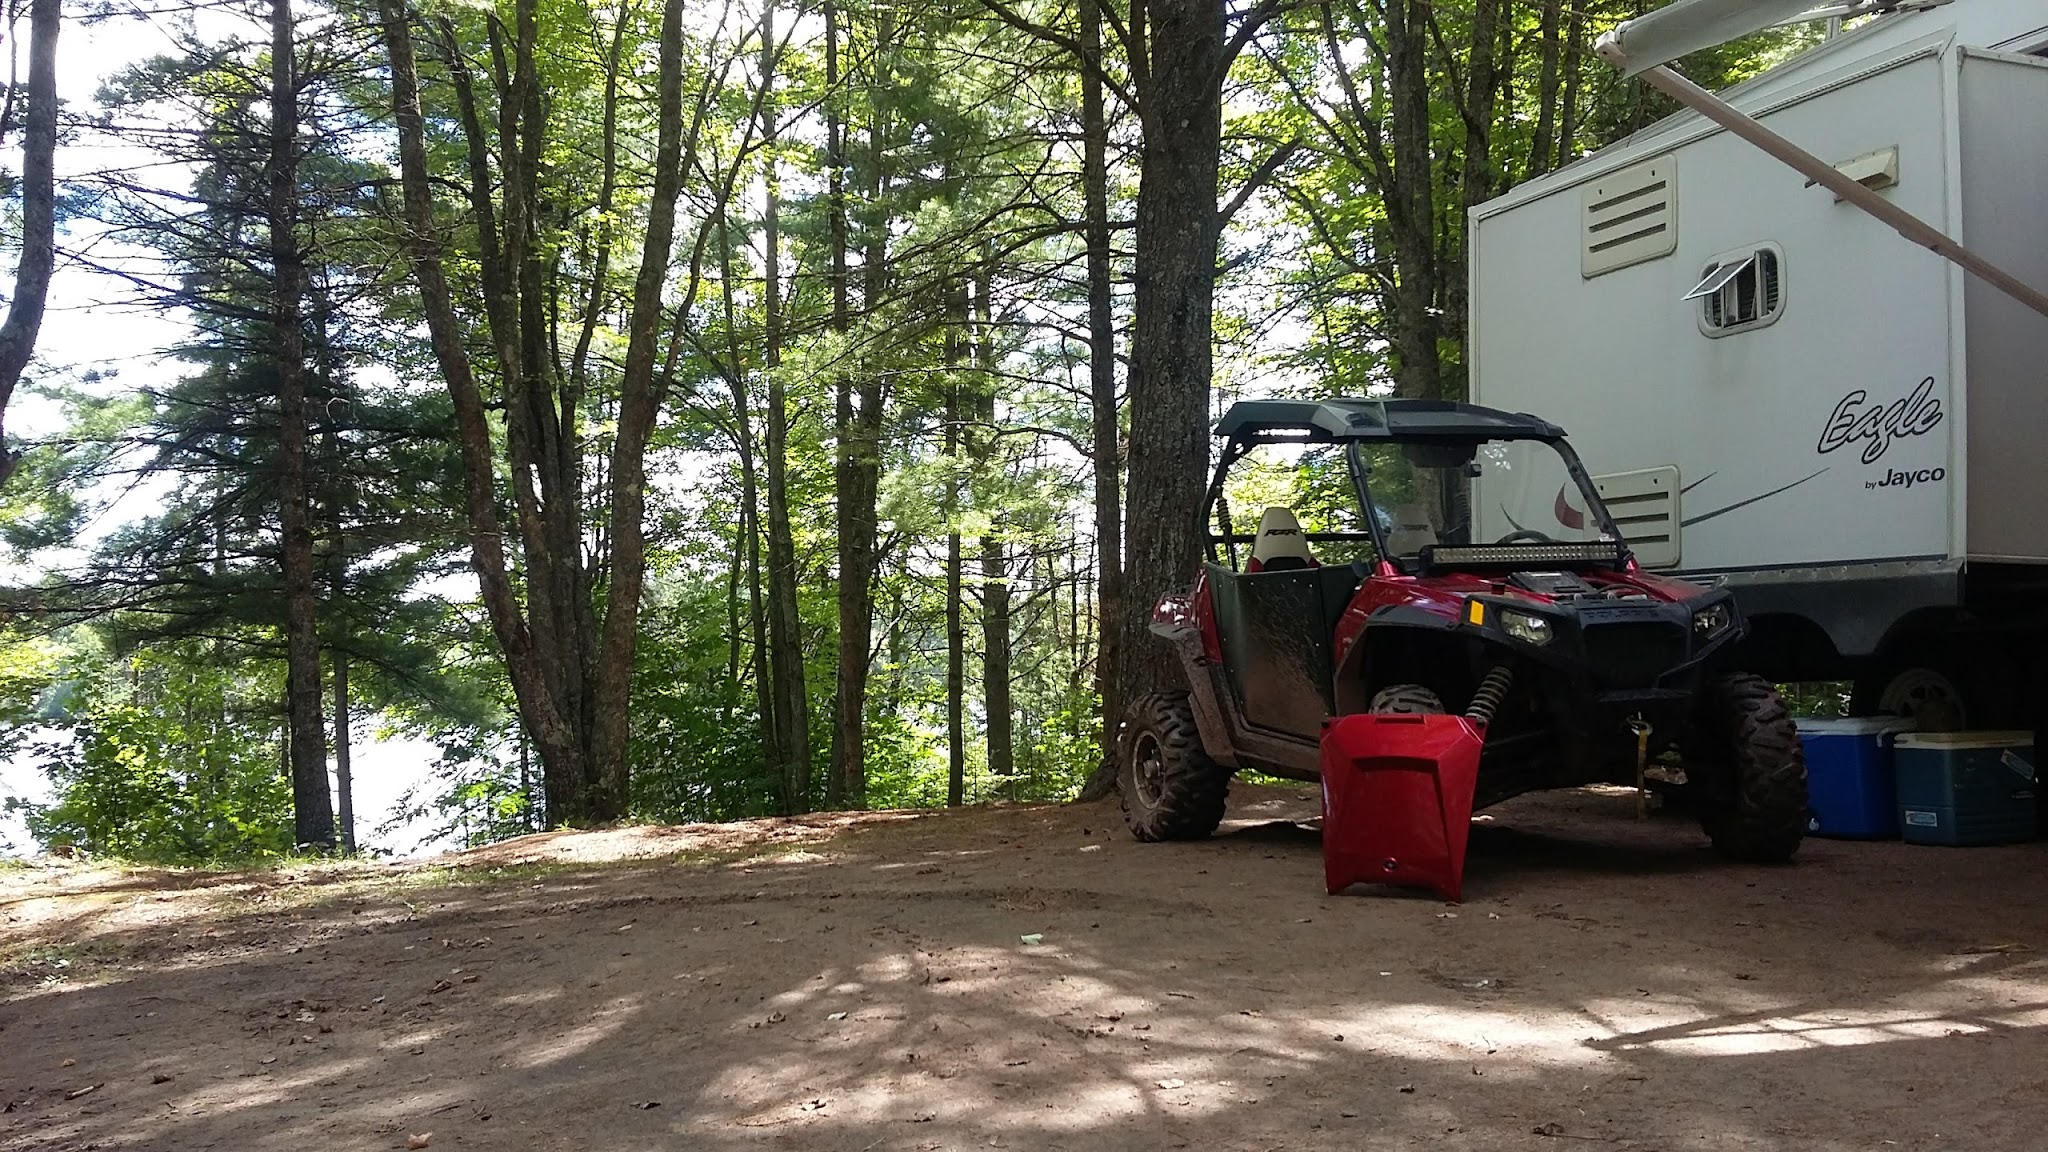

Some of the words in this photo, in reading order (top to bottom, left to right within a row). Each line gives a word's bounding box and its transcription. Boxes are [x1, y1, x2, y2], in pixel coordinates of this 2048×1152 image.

[1817, 376, 1943, 464] Eagle
[1865, 481, 1876, 490] by
[1878, 467, 1945, 488] Jayco
